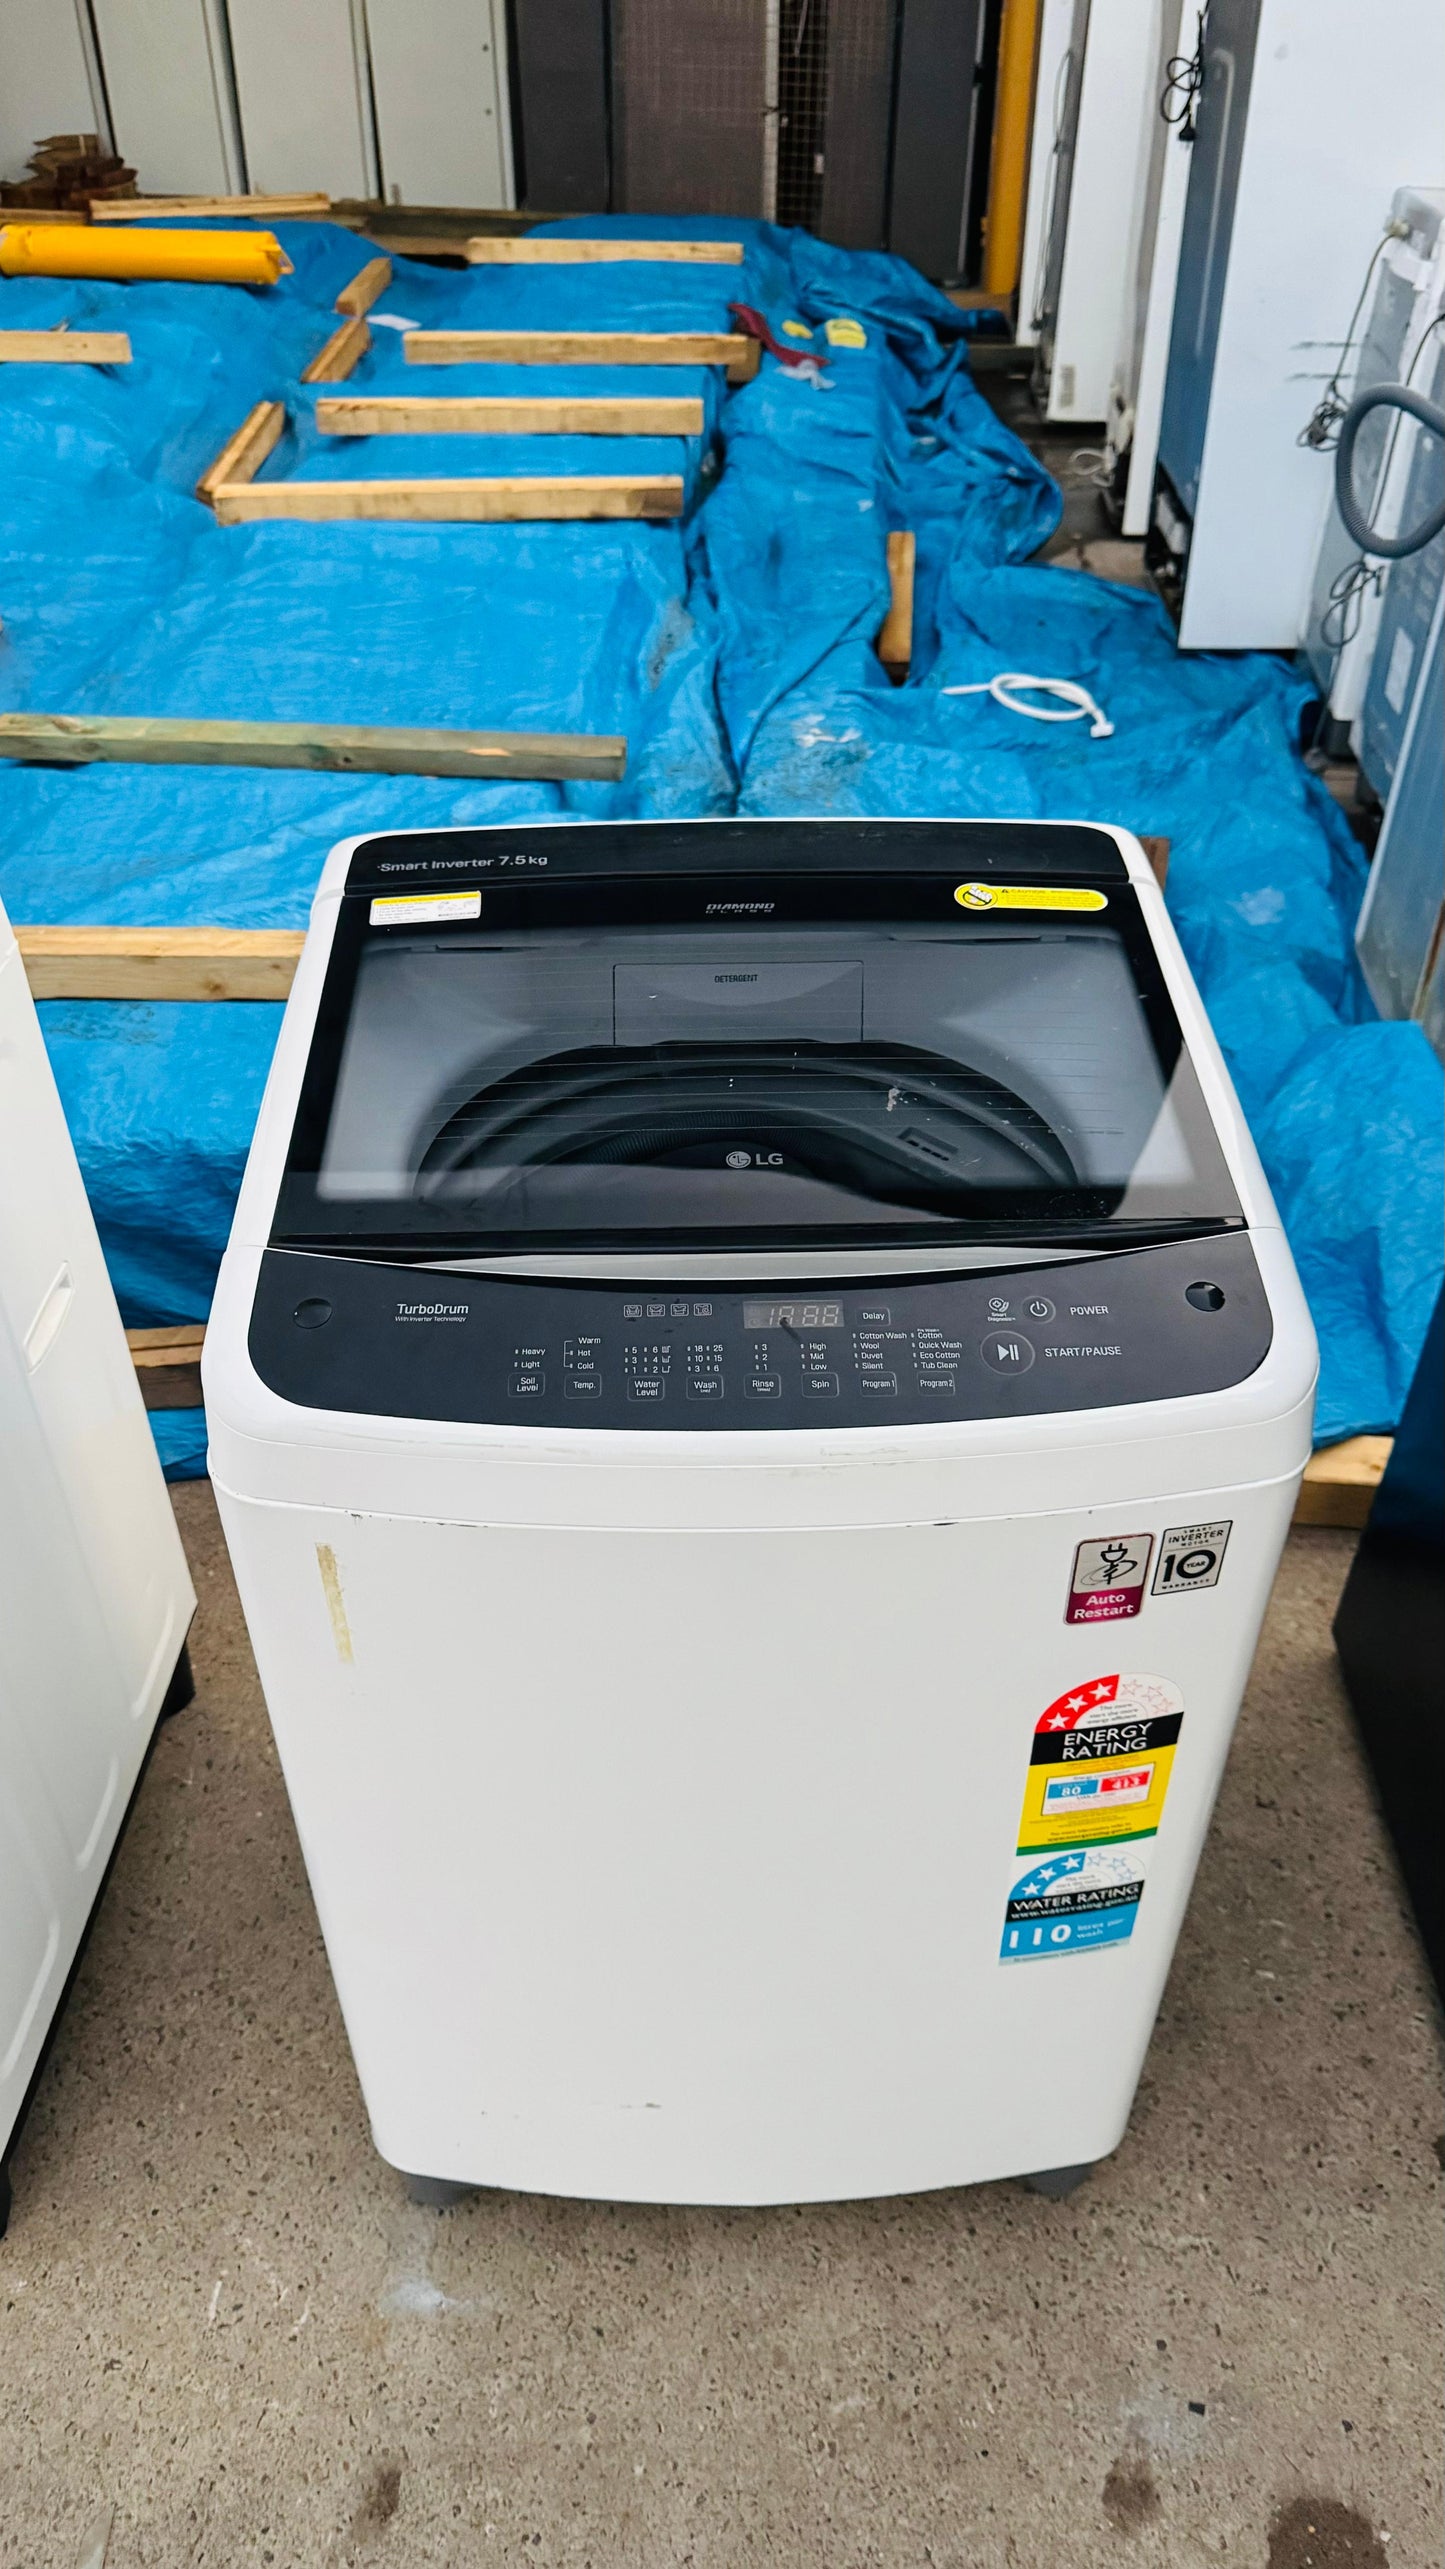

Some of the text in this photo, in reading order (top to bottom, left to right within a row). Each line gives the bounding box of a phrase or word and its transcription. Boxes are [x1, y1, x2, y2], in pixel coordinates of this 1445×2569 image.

[380, 855, 548, 872] Smart Inverter 7.5 kg
[714, 974, 758, 984] DETERGENT
[755, 1153, 784, 1165] LG
[397, 1303, 469, 1314] TurboDrum
[1069, 1305, 1109, 1316] POWER
[862, 1312, 885, 1321] Delay
[859, 1332, 907, 1340] Cotton Wash
[917, 1331, 943, 1339] Cotton
[694, 1344, 724, 1353] 18 25
[761, 1343, 768, 1351] 3
[809, 1342, 827, 1351] High
[918, 1341, 963, 1349] Quick Wash
[521, 1348, 546, 1356] Heavy
[631, 1346, 659, 1354] 5 6
[1044, 1346, 1122, 1357] START/PAUSE
[631, 1356, 638, 1364] 3
[694, 1354, 723, 1363] 10 15
[761, 1353, 768, 1361] 2
[809, 1352, 824, 1360] Mid
[520, 1361, 541, 1369] Light
[577, 1362, 594, 1370] Cold
[713, 1364, 720, 1372] 6
[920, 1361, 958, 1369] Tub Clean
[652, 1366, 659, 1374] 2
[520, 1377, 536, 1385] Soil
[573, 1381, 596, 1390] Temp.
[634, 1380, 660, 1388] Water
[694, 1381, 717, 1389] Wash
[752, 1380, 775, 1388] Rinse
[811, 1380, 830, 1389] Spin
[862, 1380, 891, 1389] Program
[920, 1380, 948, 1389] Program
[516, 1384, 539, 1392] Level
[1168, 1529, 1224, 1543] INVERTER
[1162, 1549, 1216, 1583] 10
[1085, 1594, 1126, 1606] Auto
[1073, 1604, 1134, 1619] Restart
[1064, 1722, 1153, 1746] ENERGY
[1062, 1737, 1148, 1760] RATING
[1061, 1786, 1081, 1797] 80
[1013, 1884, 1139, 1911] WATER RATING
[1009, 1924, 1072, 1949] 110
